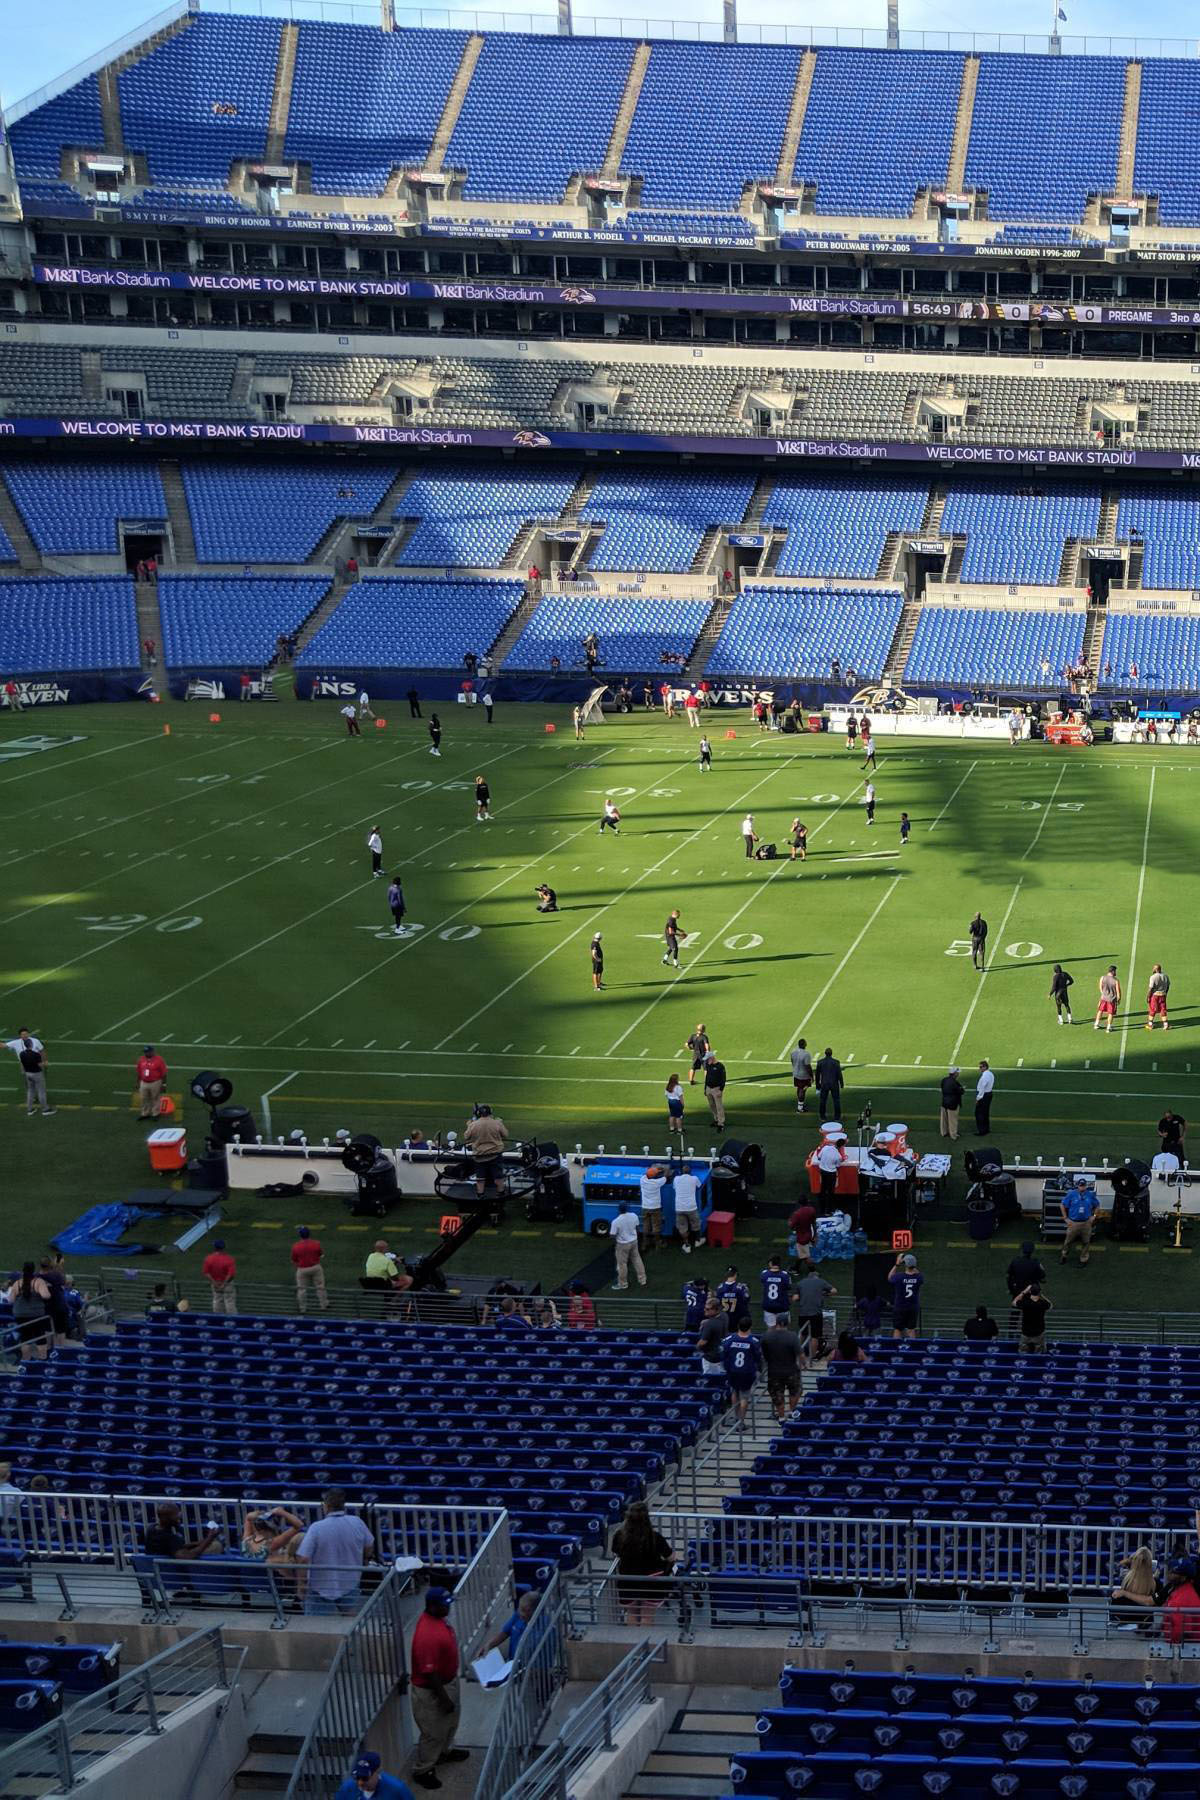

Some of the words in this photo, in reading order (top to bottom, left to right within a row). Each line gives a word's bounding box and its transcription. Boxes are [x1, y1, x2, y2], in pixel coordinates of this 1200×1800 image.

[204, 216, 226, 226] RING
[228, 217, 239, 226] OF
[240, 217, 271, 227] HONOR
[287, 220, 322, 230] EARNEST
[324, 221, 350, 231] BYNER
[351, 222, 393, 232] 1996-2003
[552, 231, 582, 240] ARTHUR
[584, 232, 591, 240] B.
[593, 232, 625, 241] MODELL
[643, 234, 676, 243] MICHAEL
[678, 235, 712, 244] McCRARY
[714, 236, 754, 246] 1997-2002
[806, 241, 830, 250] PETER
[831, 242, 870, 251] BOULWARE
[872, 243, 911, 252] 1997-2005
[974, 246, 1013, 256] JONATHAN
[1014, 247, 1041, 257] OGDEN
[1042, 249, 1081, 258] 1996-2007
[1137, 251, 1155, 261] MATT
[1156, 253, 1186, 262] STOVER
[44, 267, 81, 283] M&T
[81, 271, 115, 285] Bank
[116, 271, 170, 287] Stadium
[189, 275, 261, 291] WELCOME
[264, 279, 284, 291] TO
[287, 280, 319, 292] M&T
[321, 280, 357, 294] BANK
[360, 281, 410, 296] STADIU
[434, 285, 464, 299] M&T
[465, 286, 495, 299] Bank
[496, 286, 544, 301] Stadium
[790, 298, 820, 312] M&T
[820, 300, 849, 313] Bank
[850, 300, 896, 315] Stadium
[913, 304, 951, 316] 56:49
[1011, 307, 1021, 318] 0
[1085, 309, 1094, 321] 0
[1108, 311, 1152, 323] PREGAME
[1170, 312, 1190, 324] 3RD
[62, 421, 141, 436] WELCOME
[145, 423, 167, 436] TO
[171, 424, 204, 437] M&T
[207, 424, 246, 438] BANK
[250, 425, 304, 439] STADIU
[355, 428, 389, 442] M&T
[389, 429, 420, 442] Bank
[421, 429, 472, 445] Stadium
[776, 440, 808, 454] M&T
[808, 442, 838, 455] Bank
[839, 442, 887, 457] Stadium
[926, 447, 993, 460] WELCOME
[996, 449, 1014, 462] TO
[1018, 450, 1045, 462] M&T
[1049, 451, 1083, 463] BANK
[1087, 451, 1136, 465] STADIU
[443, 1218, 459, 1233] 40
[894, 1233, 910, 1248] 50
[767, 1284, 779, 1299] 8
[905, 1284, 913, 1298] 5
[721, 1298, 738, 1312] 57
[735, 1351, 745, 1367] 8
